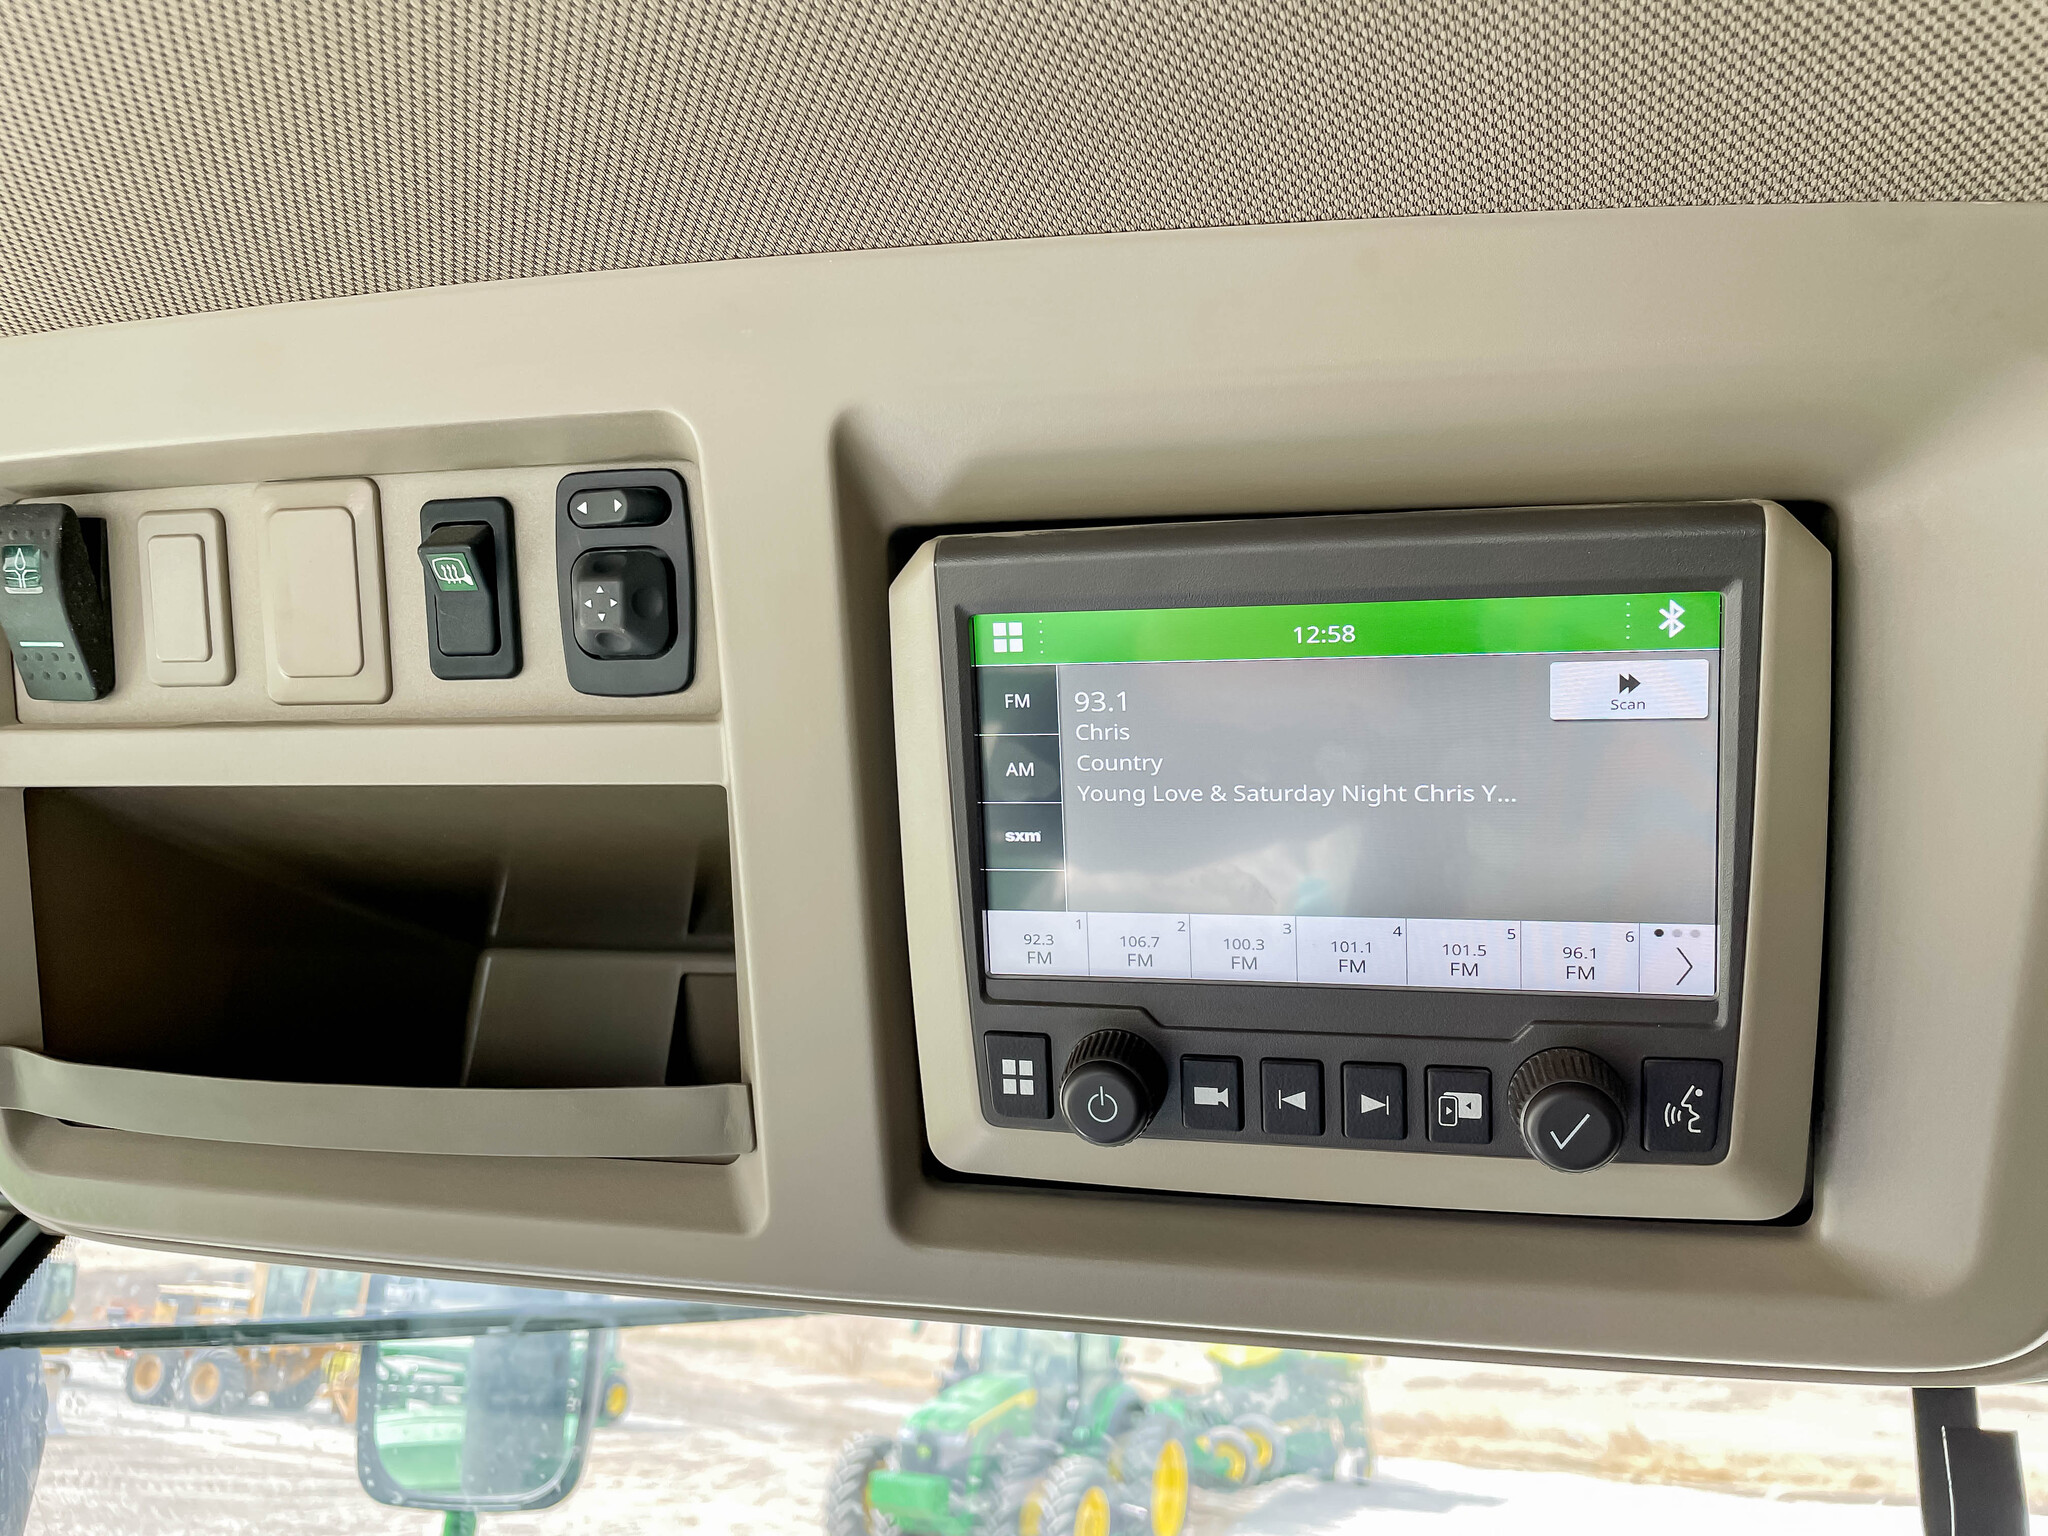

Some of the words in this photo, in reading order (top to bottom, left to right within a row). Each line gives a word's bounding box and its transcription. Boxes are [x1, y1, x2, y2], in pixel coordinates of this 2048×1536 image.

[1293, 625, 1356, 644] 12:58
[1004, 694, 1031, 708] FM
[1074, 691, 1128, 712] 93.1
[1610, 699, 1646, 711] Scan
[1075, 723, 1130, 741] Chris
[1006, 763, 1035, 777] AM
[1076, 755, 1163, 775] Country
[1077, 785, 1146, 806] Young
[1153, 784, 1203, 802] Love
[1210, 784, 1227, 802] &
[1233, 784, 1335, 806] Saturday
[1342, 784, 1407, 807] Night
[1415, 784, 1475, 803] Chris
[1005, 830, 1041, 842] sxm
[1075, 919, 1082, 930] 1
[1177, 920, 1186, 932] 2
[1283, 923, 1292, 935] 3
[1393, 926, 1402, 937] 4
[1023, 933, 1054, 946] 92.3
[1507, 928, 1516, 940] 5
[1625, 931, 1634, 943] 6
[1120, 935, 1159, 948] 106.7
[1223, 938, 1265, 951] 100.3
[1331, 940, 1372, 953] 101.1
[1443, 943, 1487, 957] 101.5
[1563, 947, 1597, 960] 96.1
[1027, 951, 1052, 965] FM
[1128, 953, 1153, 967] FM
[1231, 956, 1258, 970] FM
[1339, 959, 1366, 973] FM
[1450, 963, 1479, 977] FM
[1566, 966, 1595, 980] FM
